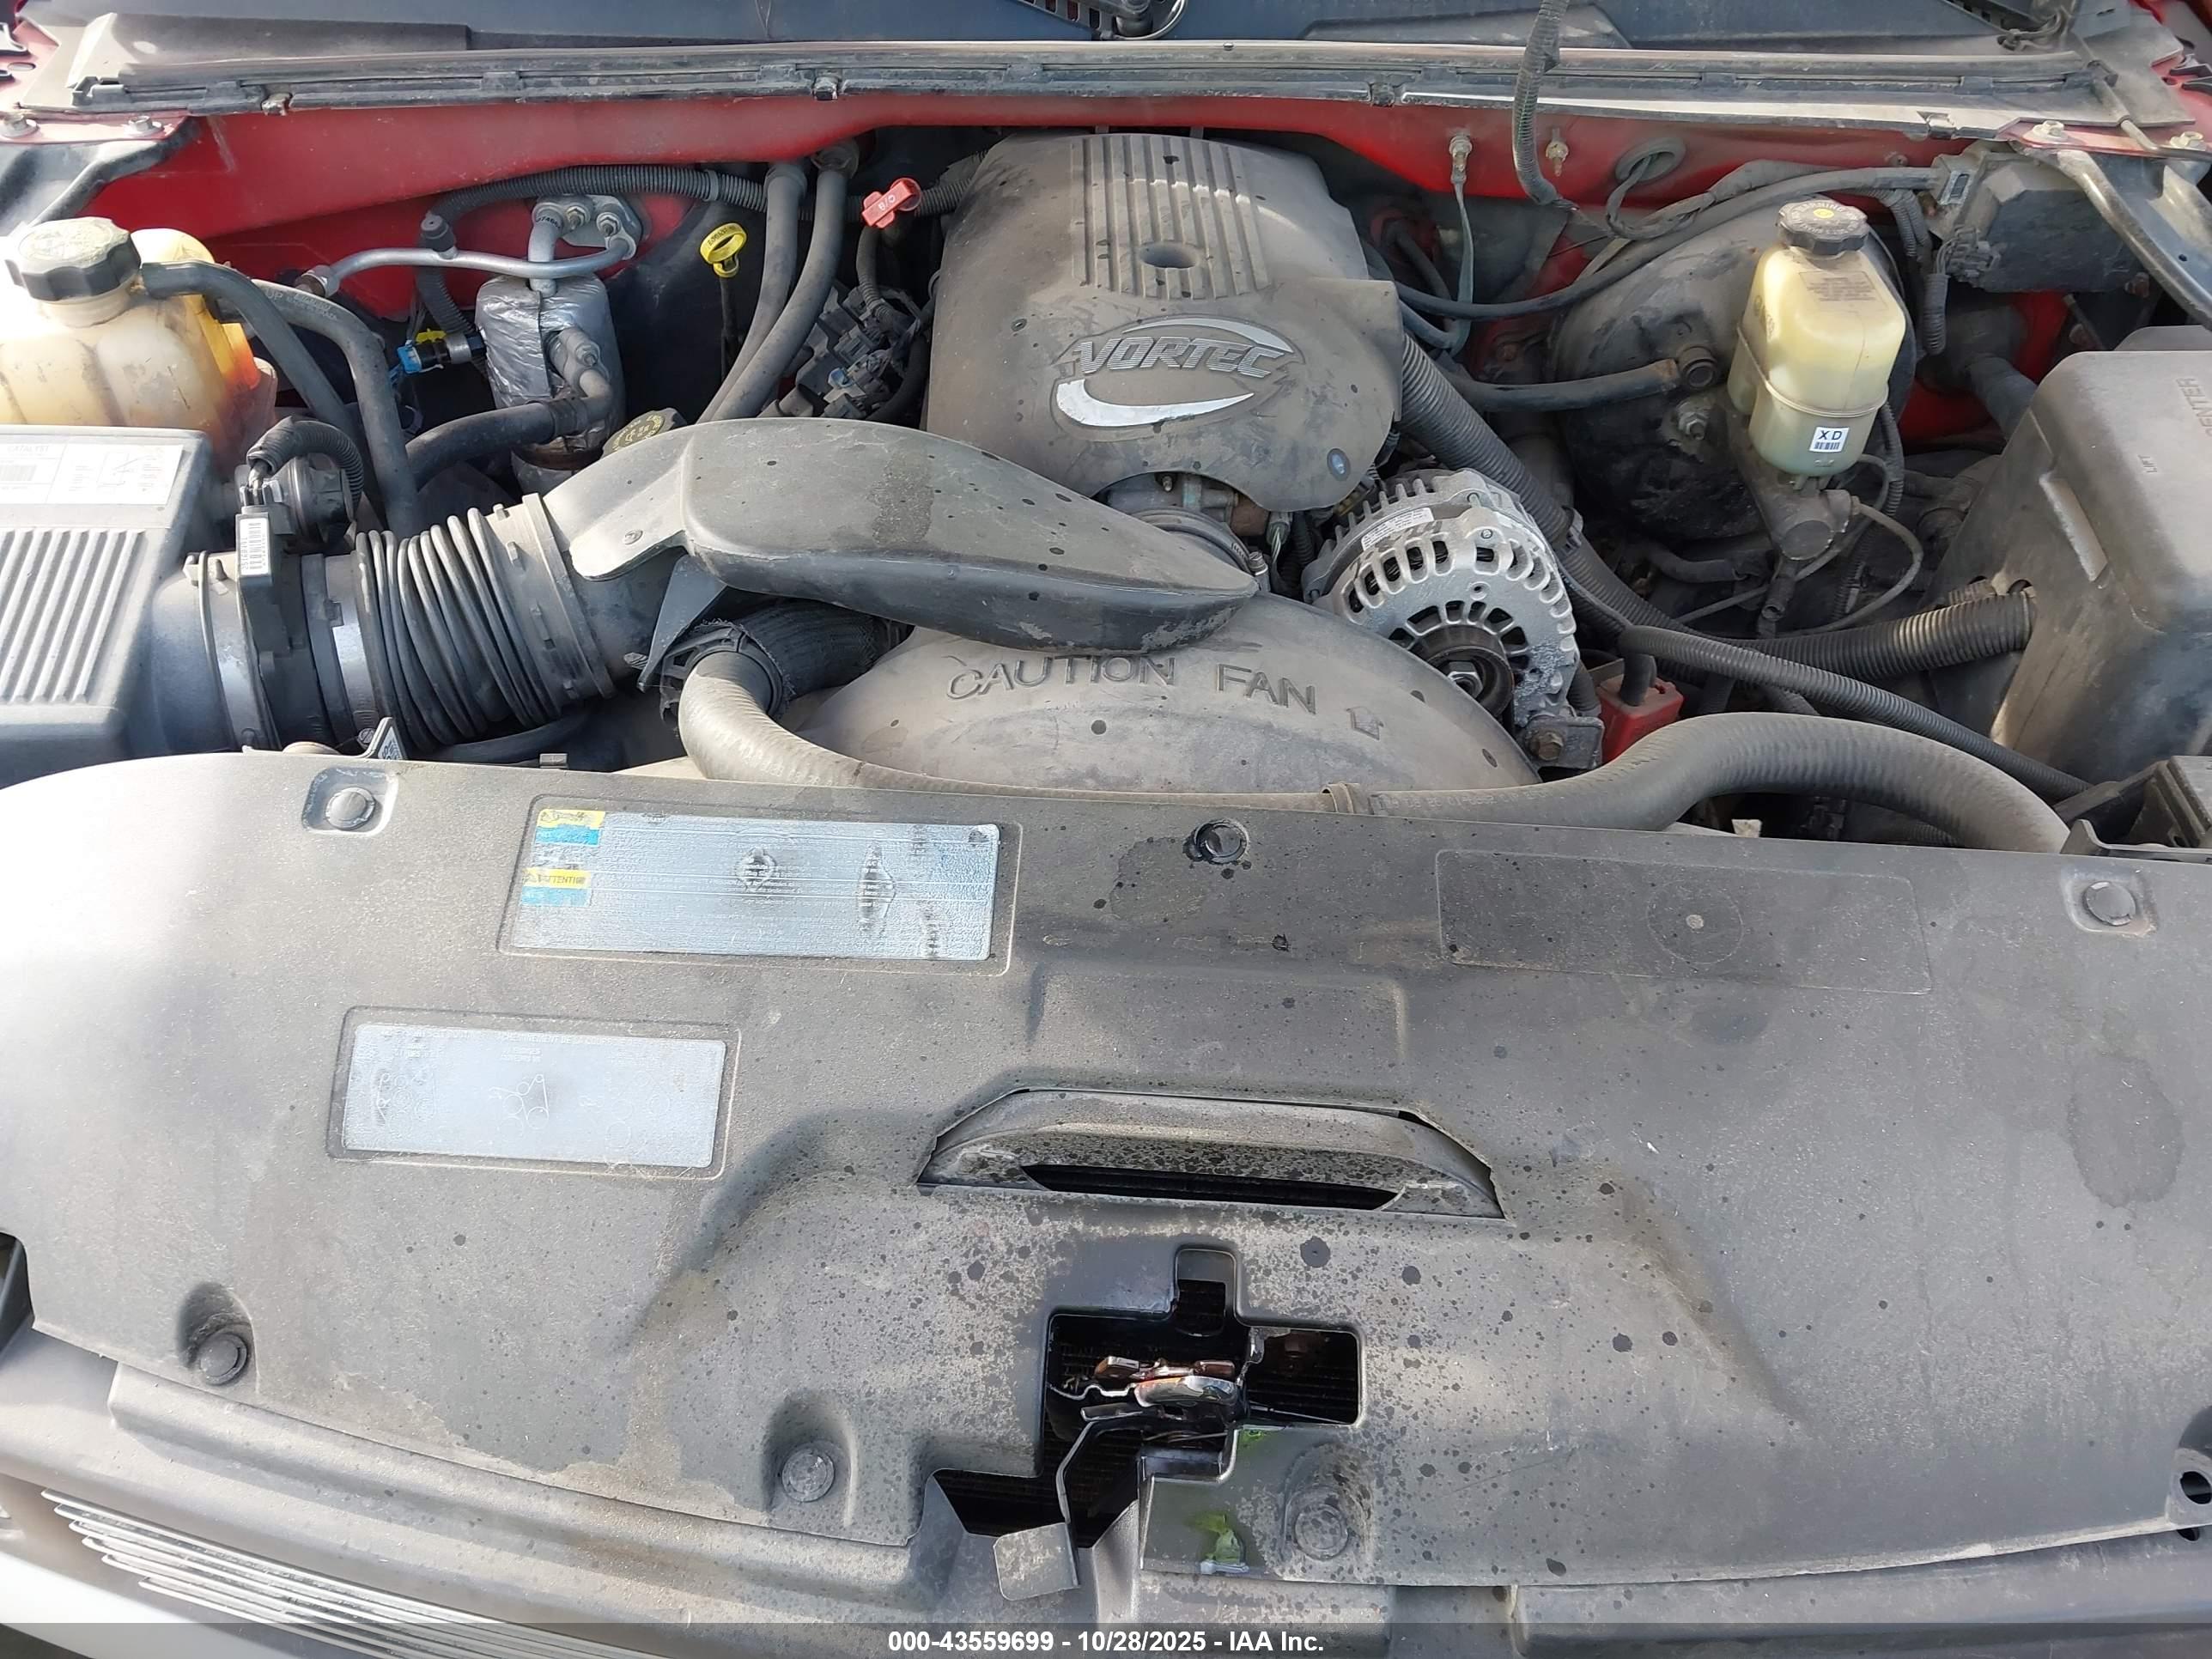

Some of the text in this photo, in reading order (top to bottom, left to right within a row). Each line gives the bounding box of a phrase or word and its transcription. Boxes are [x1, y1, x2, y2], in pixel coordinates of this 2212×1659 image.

[1073, 336, 1285, 379] VORTEC
[2137, 454, 2158, 474] LIFT
[946, 654, 1316, 715] CAUTION FAN
[537, 874, 586, 884] TENTI
